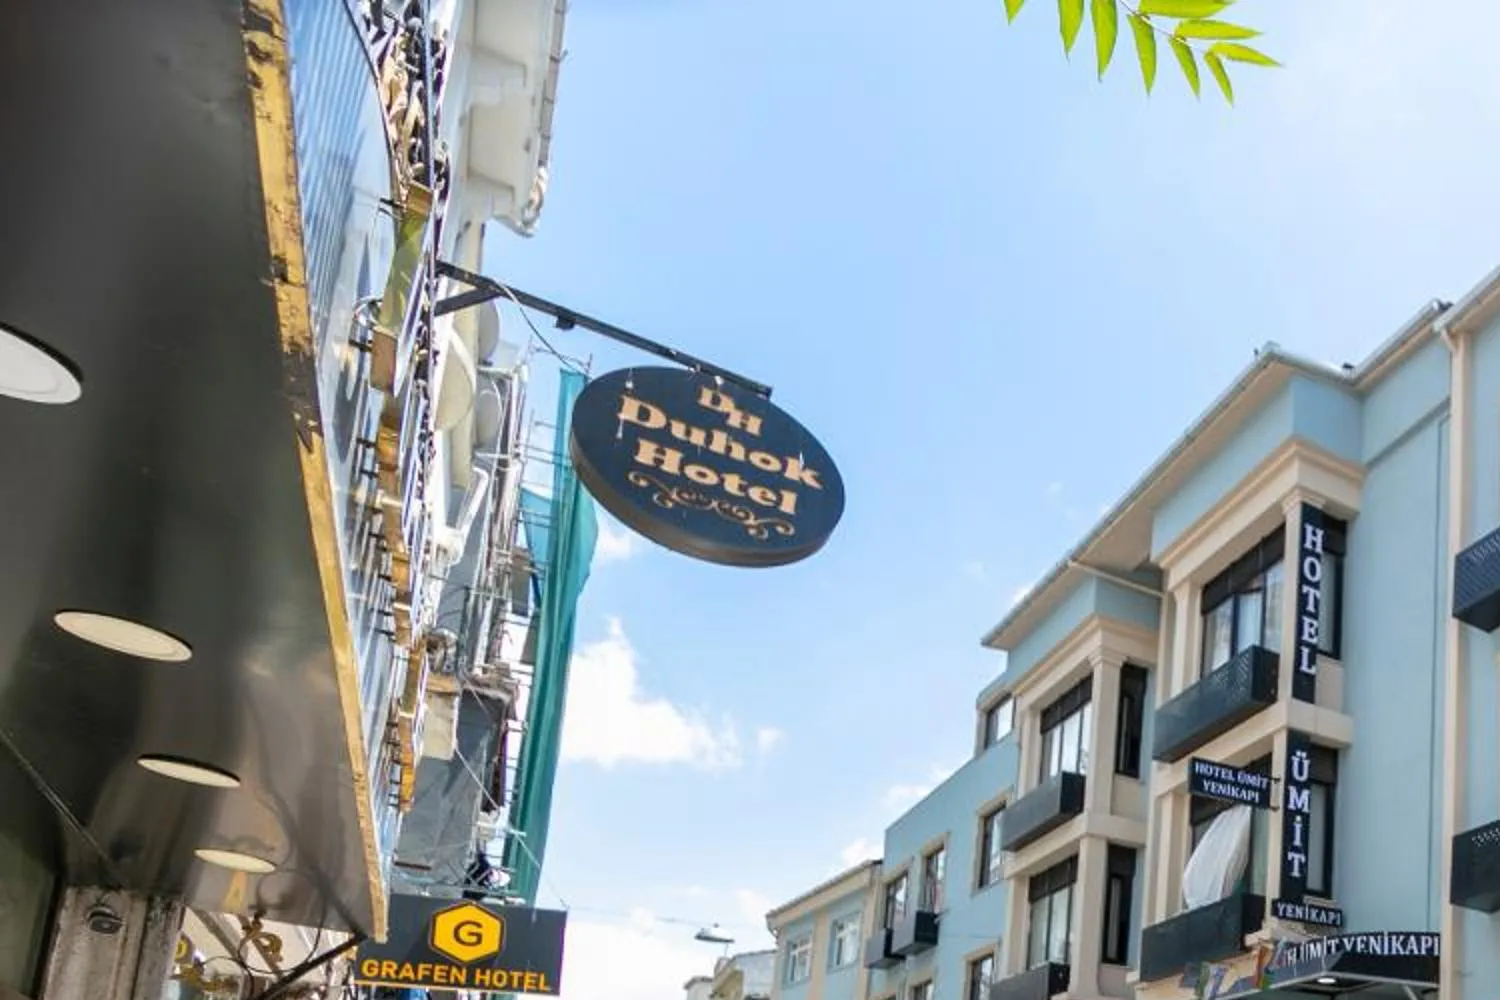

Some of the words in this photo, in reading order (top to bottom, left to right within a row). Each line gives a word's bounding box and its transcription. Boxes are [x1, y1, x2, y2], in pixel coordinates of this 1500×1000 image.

[618, 394, 823, 490] Duhok
[633, 438, 799, 515] Hotel
[1300, 523, 1325, 676] HOTEL
[1195, 762, 1236, 781] HOTEL
[1203, 779, 1260, 803] YENİKAPI
[1288, 750, 1311, 878] ÜMİT
[1277, 902, 1341, 926] YENİKAPI
[453, 920, 484, 948] G
[1340, 931, 1440, 956] YENİKAPI
[361, 958, 467, 986] GRAFEN
[474, 966, 552, 991] HOTEL
